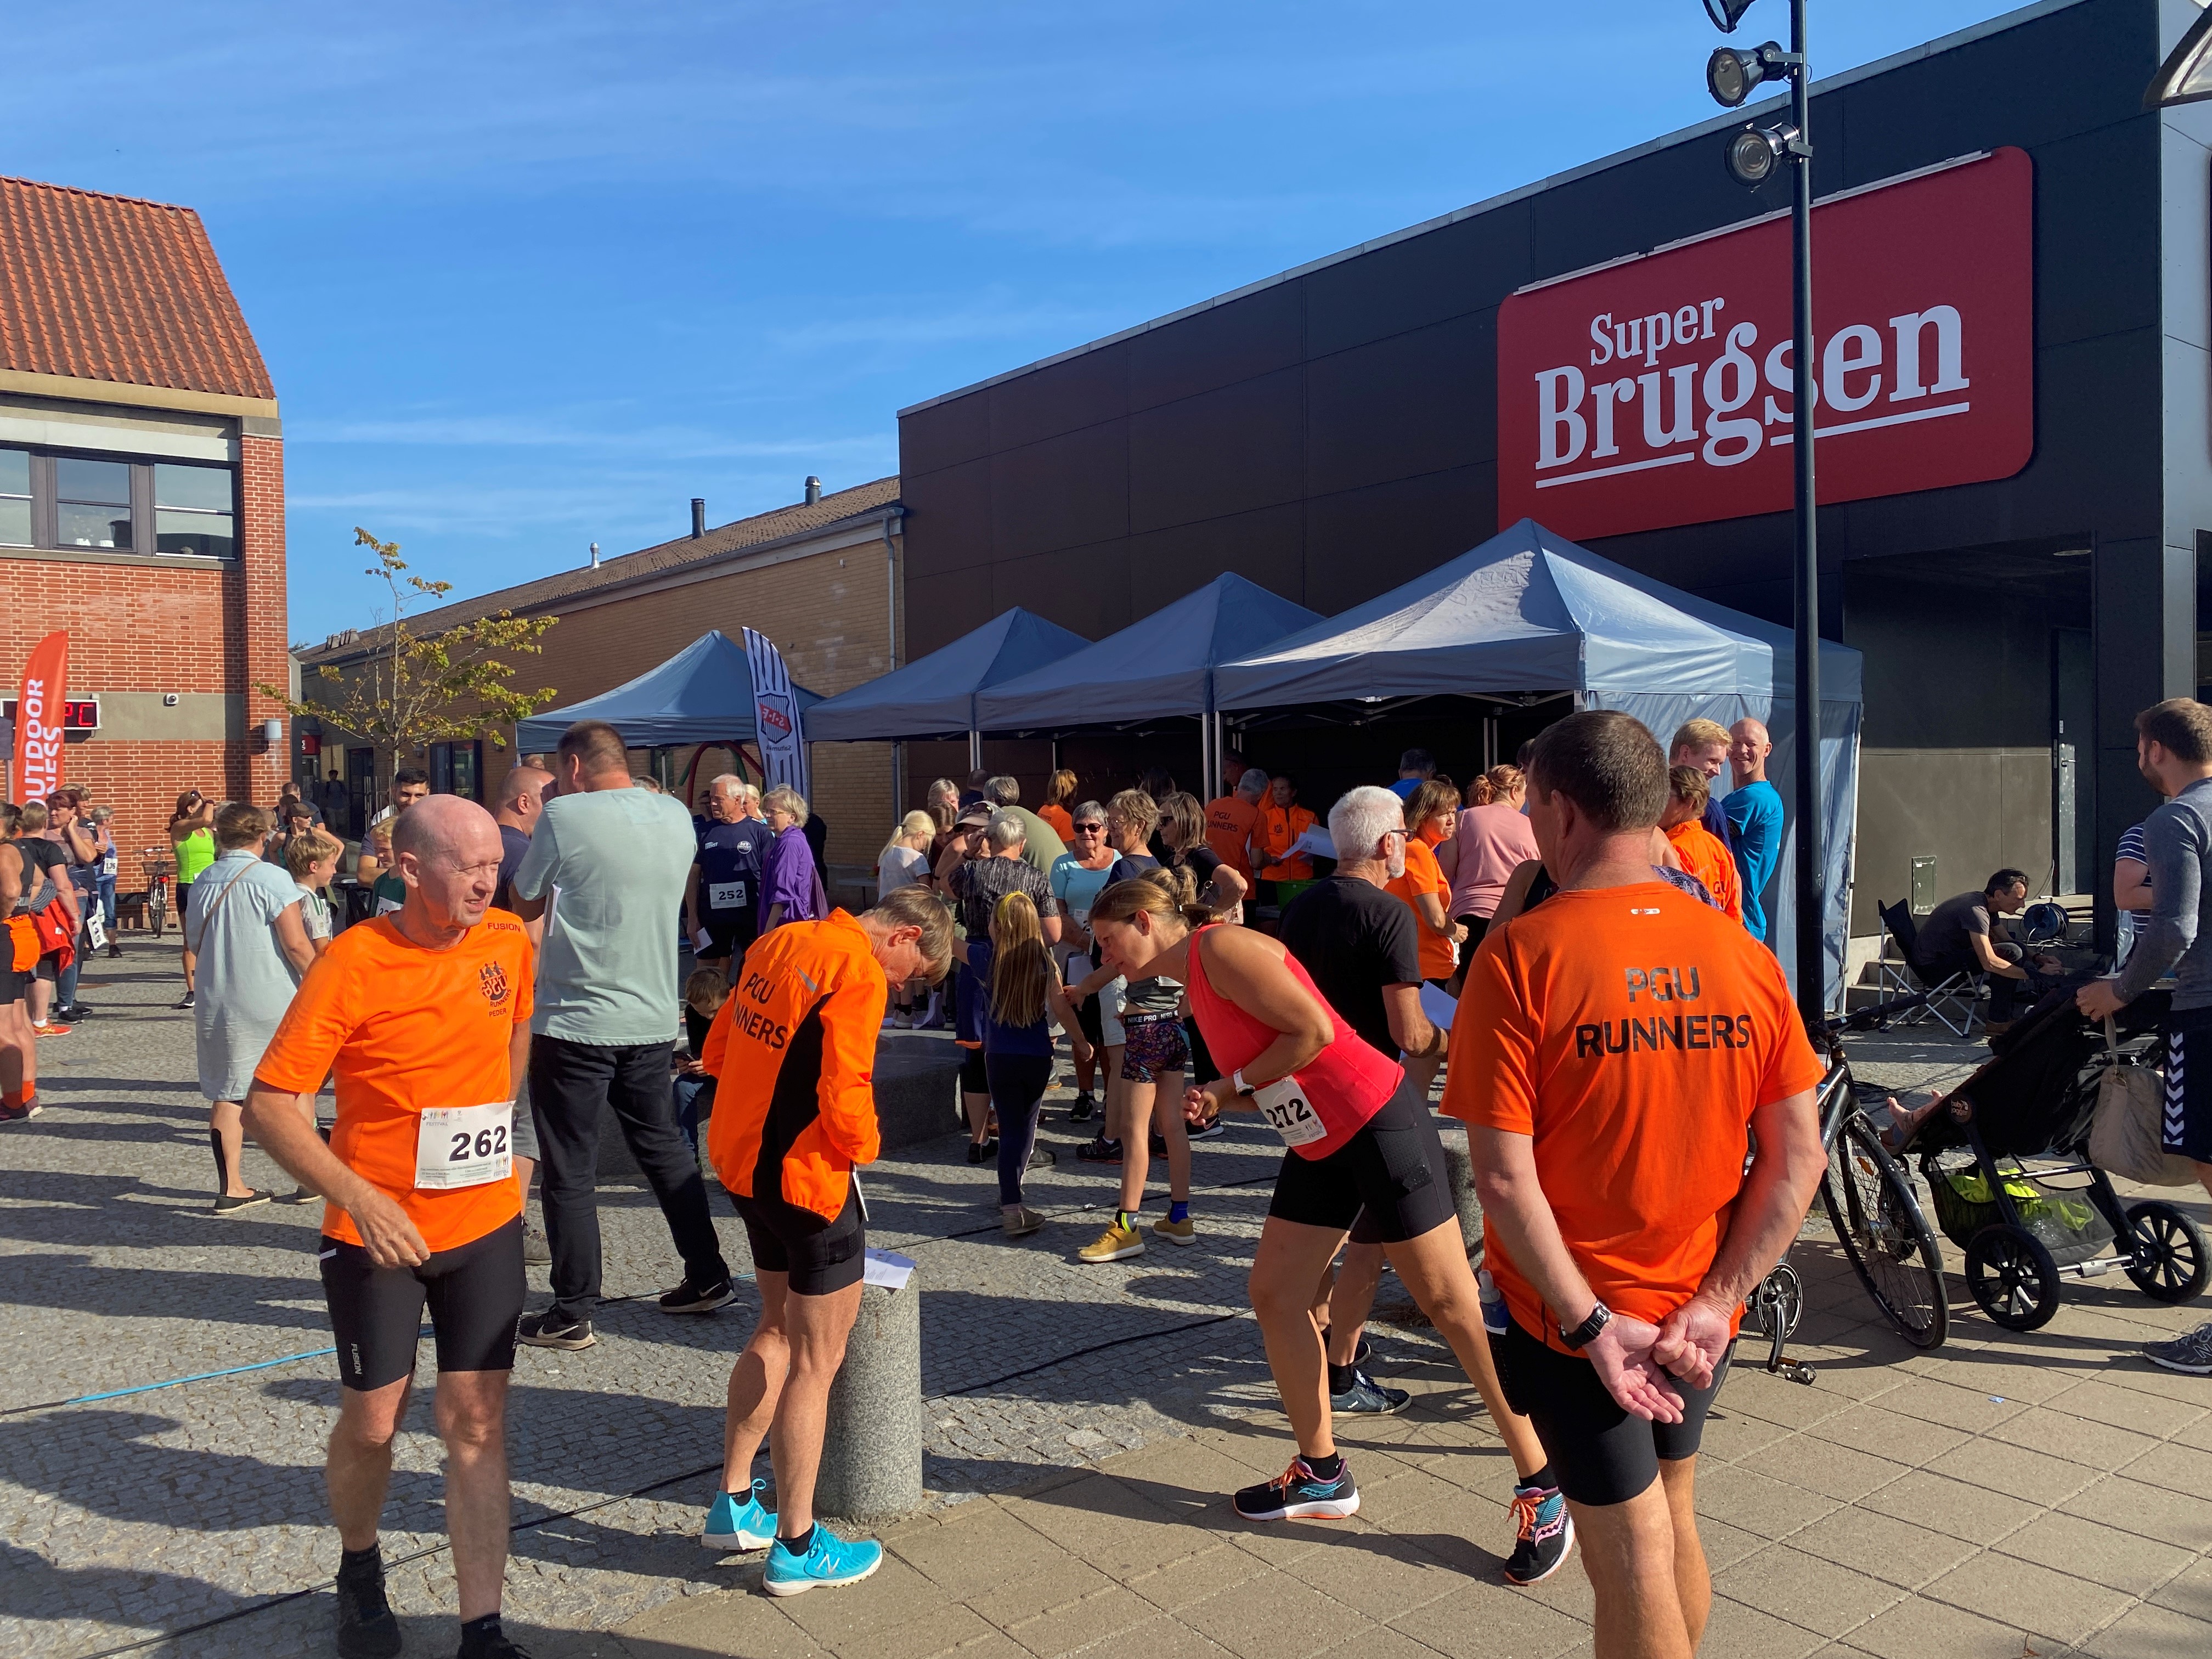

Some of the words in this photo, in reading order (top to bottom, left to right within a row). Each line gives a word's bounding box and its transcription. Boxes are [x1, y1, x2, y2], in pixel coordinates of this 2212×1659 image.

[1590, 296, 1725, 366] Super
[1534, 304, 1970, 470] Brugsen
[1207, 820, 1238, 832] UNNERS
[1214, 811, 1231, 820] PGU
[719, 889, 743, 900] 252
[487, 922, 521, 933] FUSION
[490, 988, 512, 1007] RUNNERS
[742, 972, 776, 1005] PGU
[1624, 967, 1700, 1003] PGU
[489, 1008, 507, 1018] PEDER
[1576, 1014, 1752, 1058] RUNNERS
[1266, 1098, 1312, 1129] 272
[1951, 1099, 1963, 1110] baby
[449, 1125, 506, 1162] 262
[351, 1342, 363, 1375] FUSION
